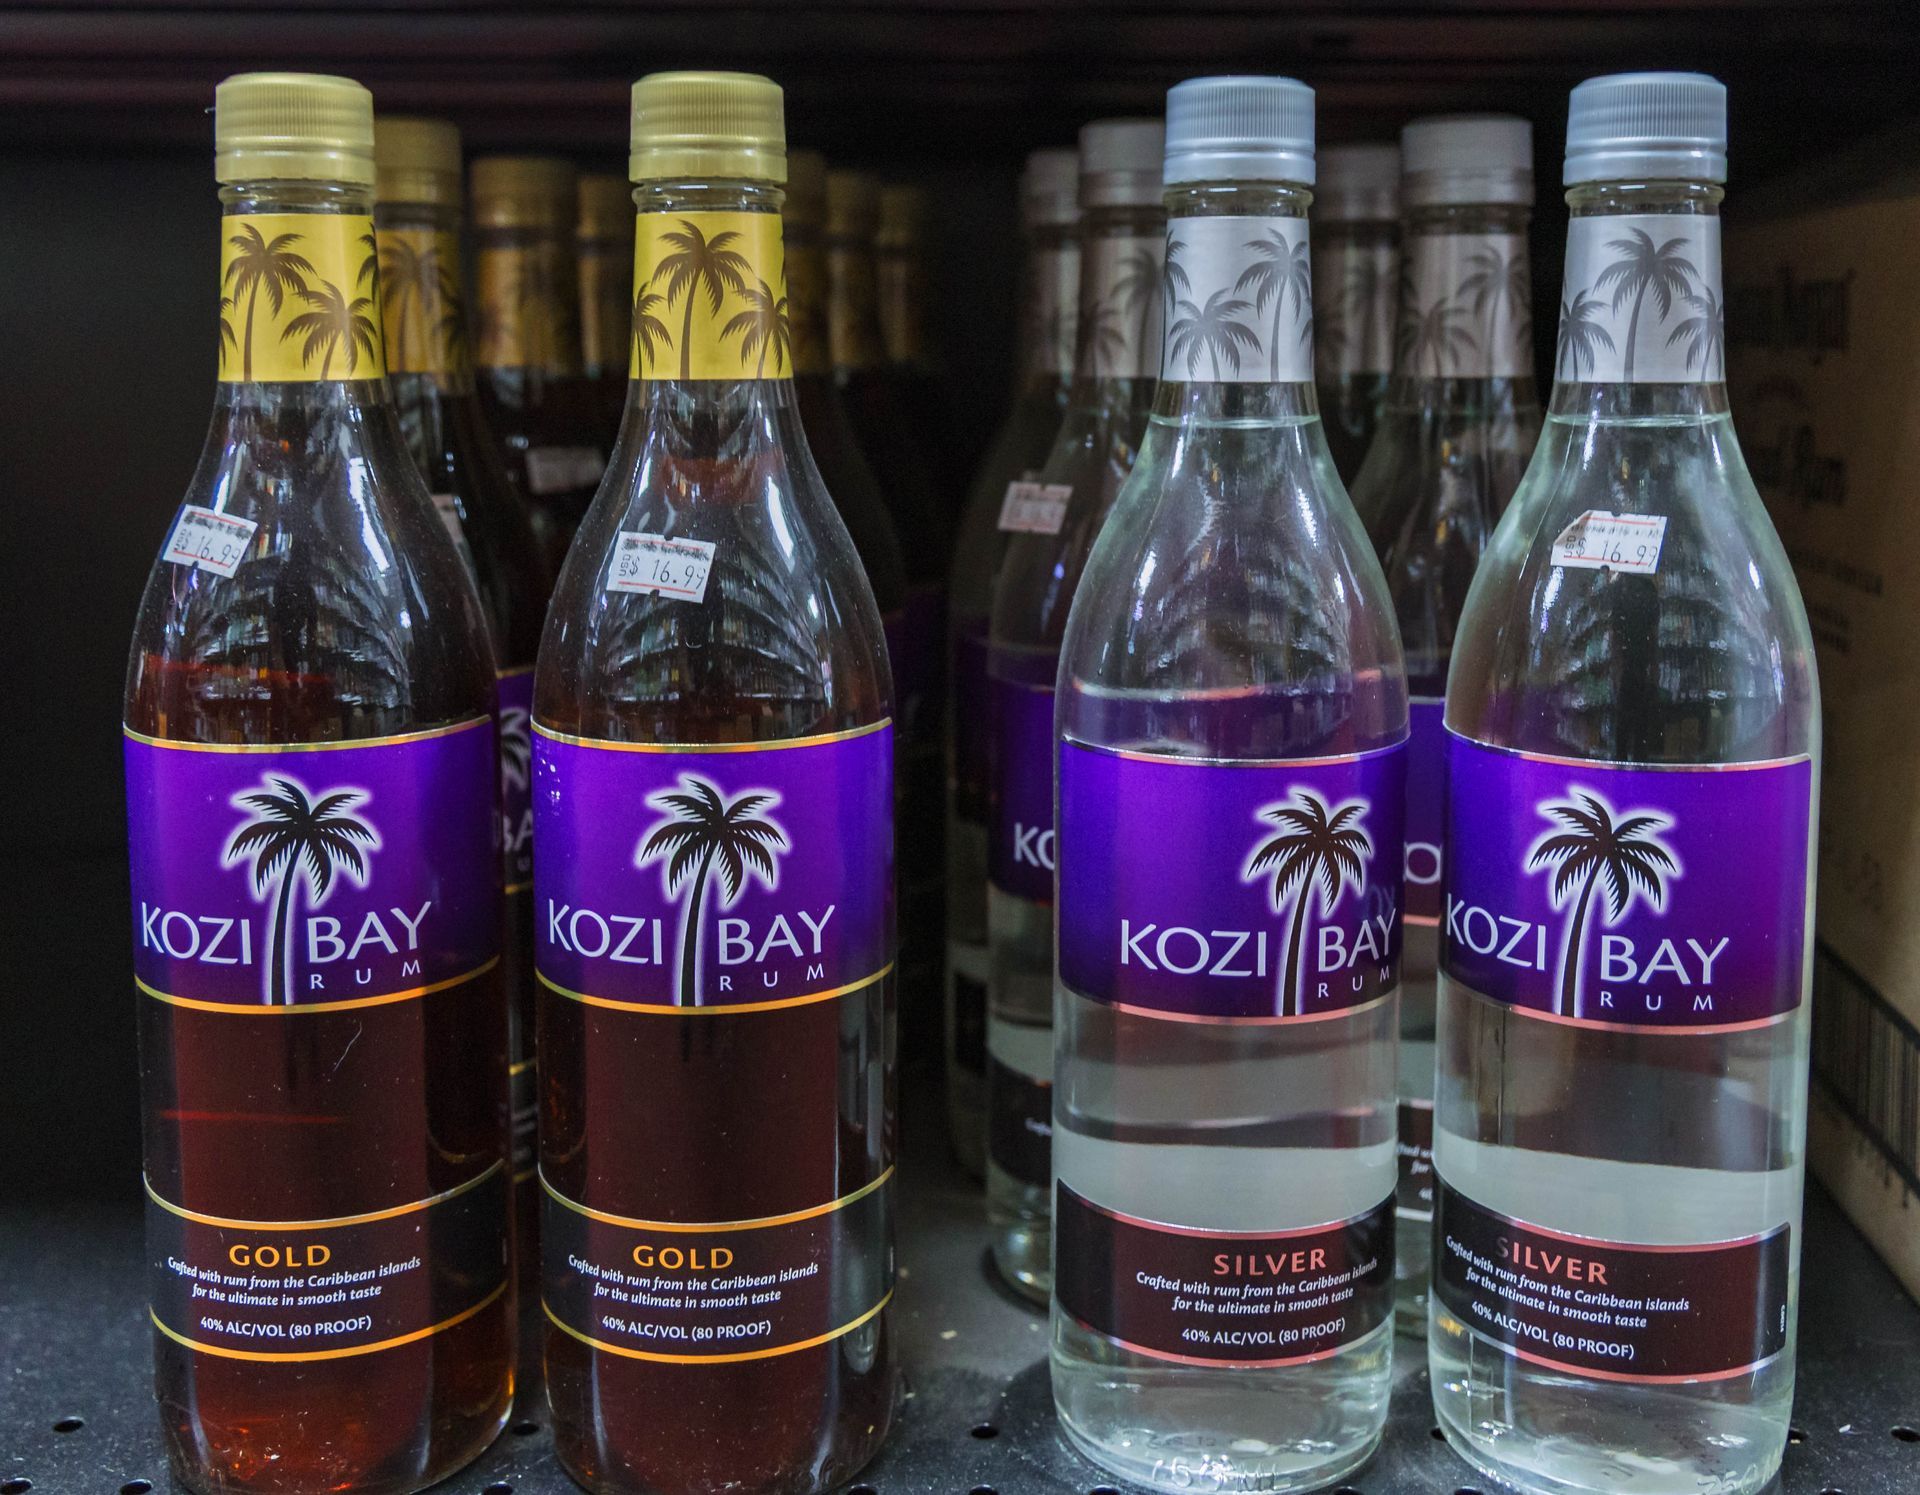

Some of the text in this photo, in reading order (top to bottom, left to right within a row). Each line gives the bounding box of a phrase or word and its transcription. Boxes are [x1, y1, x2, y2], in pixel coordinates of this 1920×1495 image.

[619, 554, 631, 577] USD
[141, 902, 431, 965] KOZI BAY
[549, 898, 835, 965] KOZI BAY
[1120, 908, 1396, 977] KOZI BAY
[1446, 893, 1546, 971] KOZI
[1601, 935, 1729, 985] BAY
[310, 960, 420, 989] RUM
[719, 963, 824, 991] RUM
[1318, 965, 1390, 998] RUM
[1600, 991, 1713, 1010] RUM
[229, 1245, 331, 1268] GOLD
[633, 1246, 734, 1270] GOLD
[1213, 1248, 1327, 1276] SILVER
[1496, 1237, 1607, 1285] SILVER
[168, 1256, 421, 1290] Crafted with rum from the Caribbean islands
[569, 1255, 818, 1291] Crafted with rum from the Caribbean islands
[1136, 1257, 1377, 1299] Crafted with rum from the Caribbean islands
[1446, 1235, 1690, 1310] Crafted with rum from the Caribbean islands
[192, 1283, 381, 1305] for the ultimate in smooth taste
[594, 1282, 782, 1308] for the ultimate in smooth taste
[1171, 1288, 1354, 1314] for the ultimate in smooth taste
[1466, 1267, 1647, 1328] for the ultimate in smooth taste
[201, 1315, 372, 1339] 40% ALC/VOL (80 PROOF)
[602, 1315, 771, 1341] 40% ALC/VOL (80 PROOF)
[1182, 1317, 1346, 1346] 40% ALC/VOL (80 PROOF)
[1472, 1301, 1634, 1360] 40% ALC/VOL (80 PROOF)
